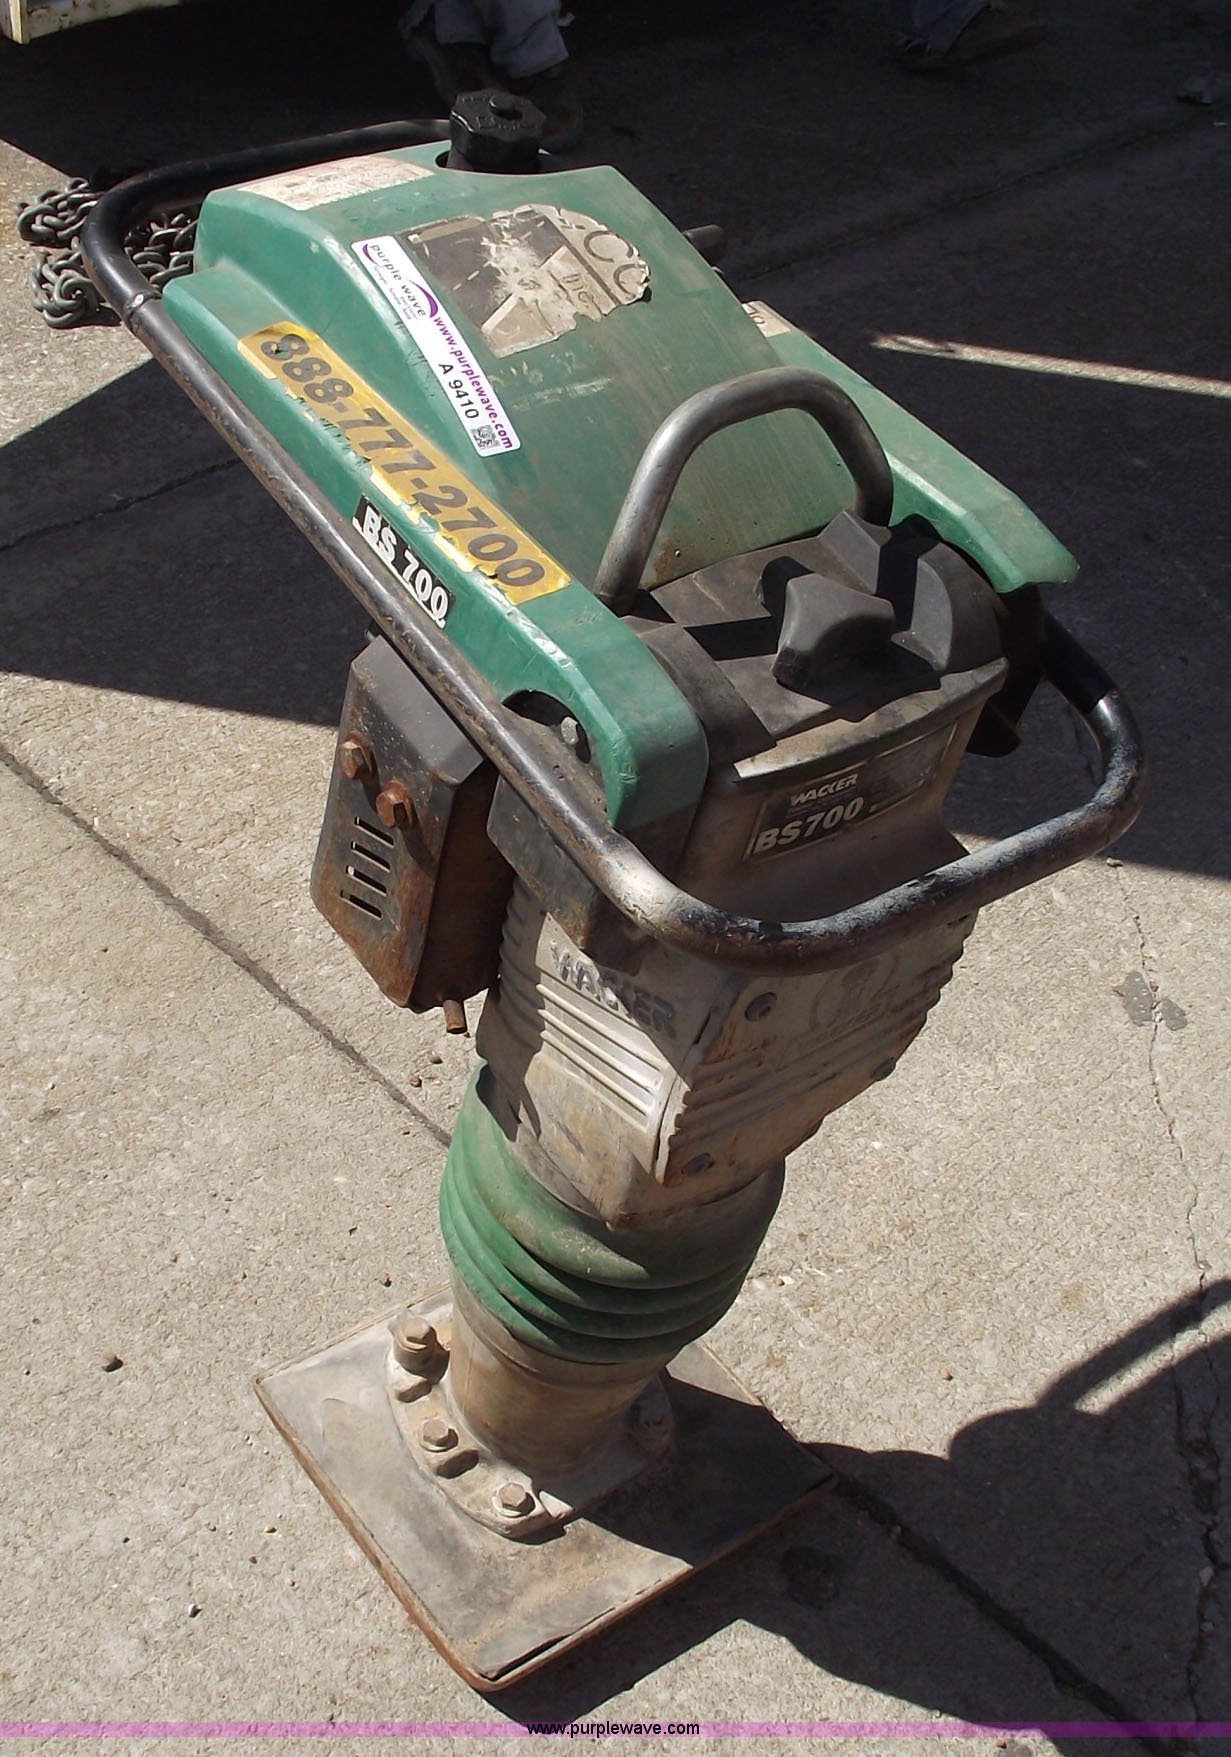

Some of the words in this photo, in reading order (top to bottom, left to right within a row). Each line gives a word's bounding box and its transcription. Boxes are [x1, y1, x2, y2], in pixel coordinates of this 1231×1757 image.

[369, 243, 402, 281] purple
[400, 284, 427, 317] wave
[433, 316, 513, 449] www.purplewave.com
[438, 363, 454, 375] A
[448, 379, 480, 420] 9410
[260, 333, 546, 588] 888-777-2700
[362, 505, 397, 558] BS
[402, 549, 449, 622] 700
[791, 773, 859, 806] WACKER
